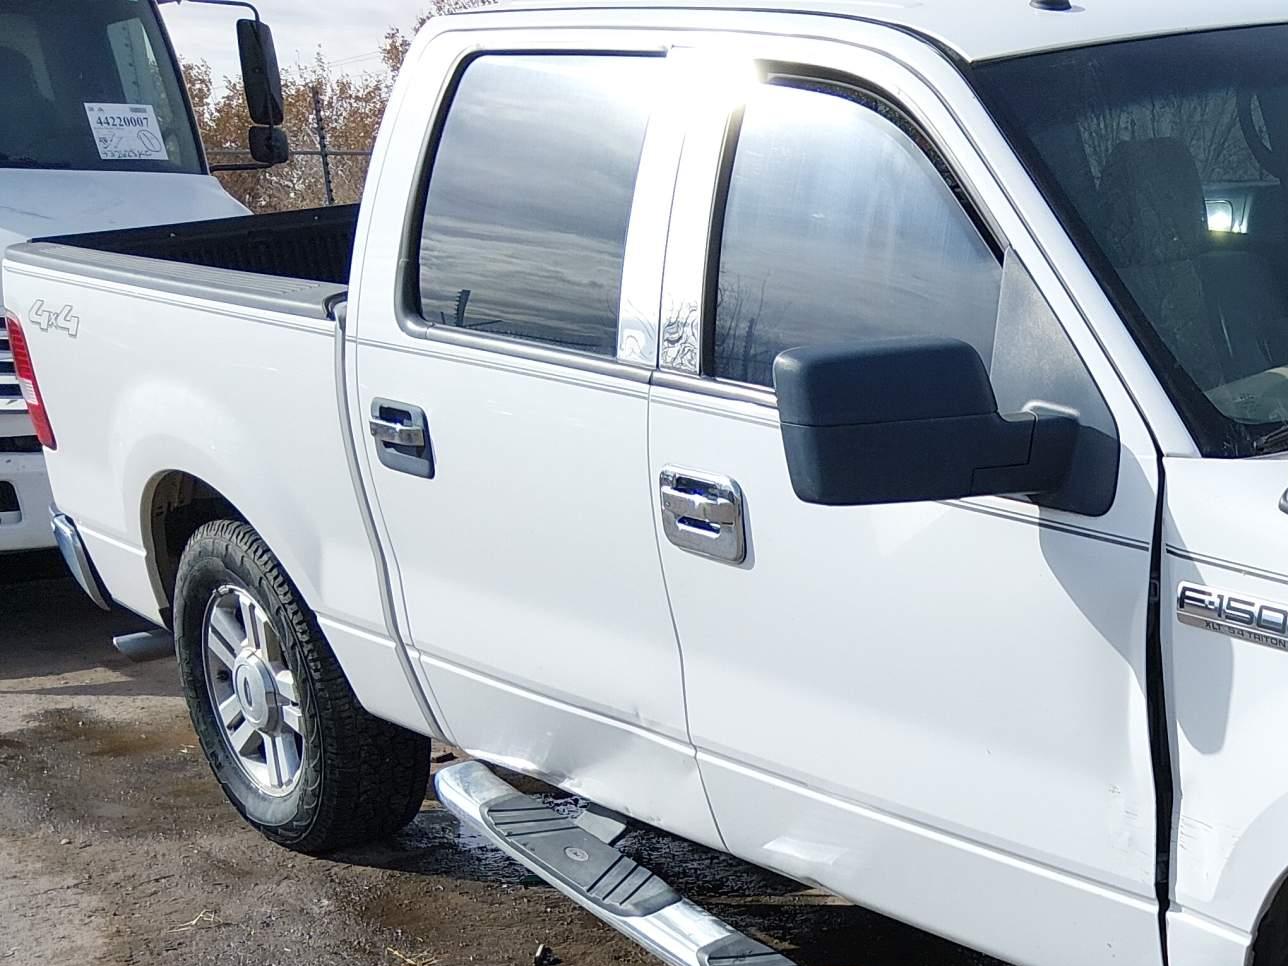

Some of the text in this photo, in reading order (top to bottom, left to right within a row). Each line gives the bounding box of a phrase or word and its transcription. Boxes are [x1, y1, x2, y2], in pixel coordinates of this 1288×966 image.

[96, 115, 149, 128] 44220007
[28, 299, 80, 338] 4x4
[1179, 586, 1288, 635] F-150
[1204, 619, 1222, 632] XLT
[1246, 631, 1287, 648] TRITON
